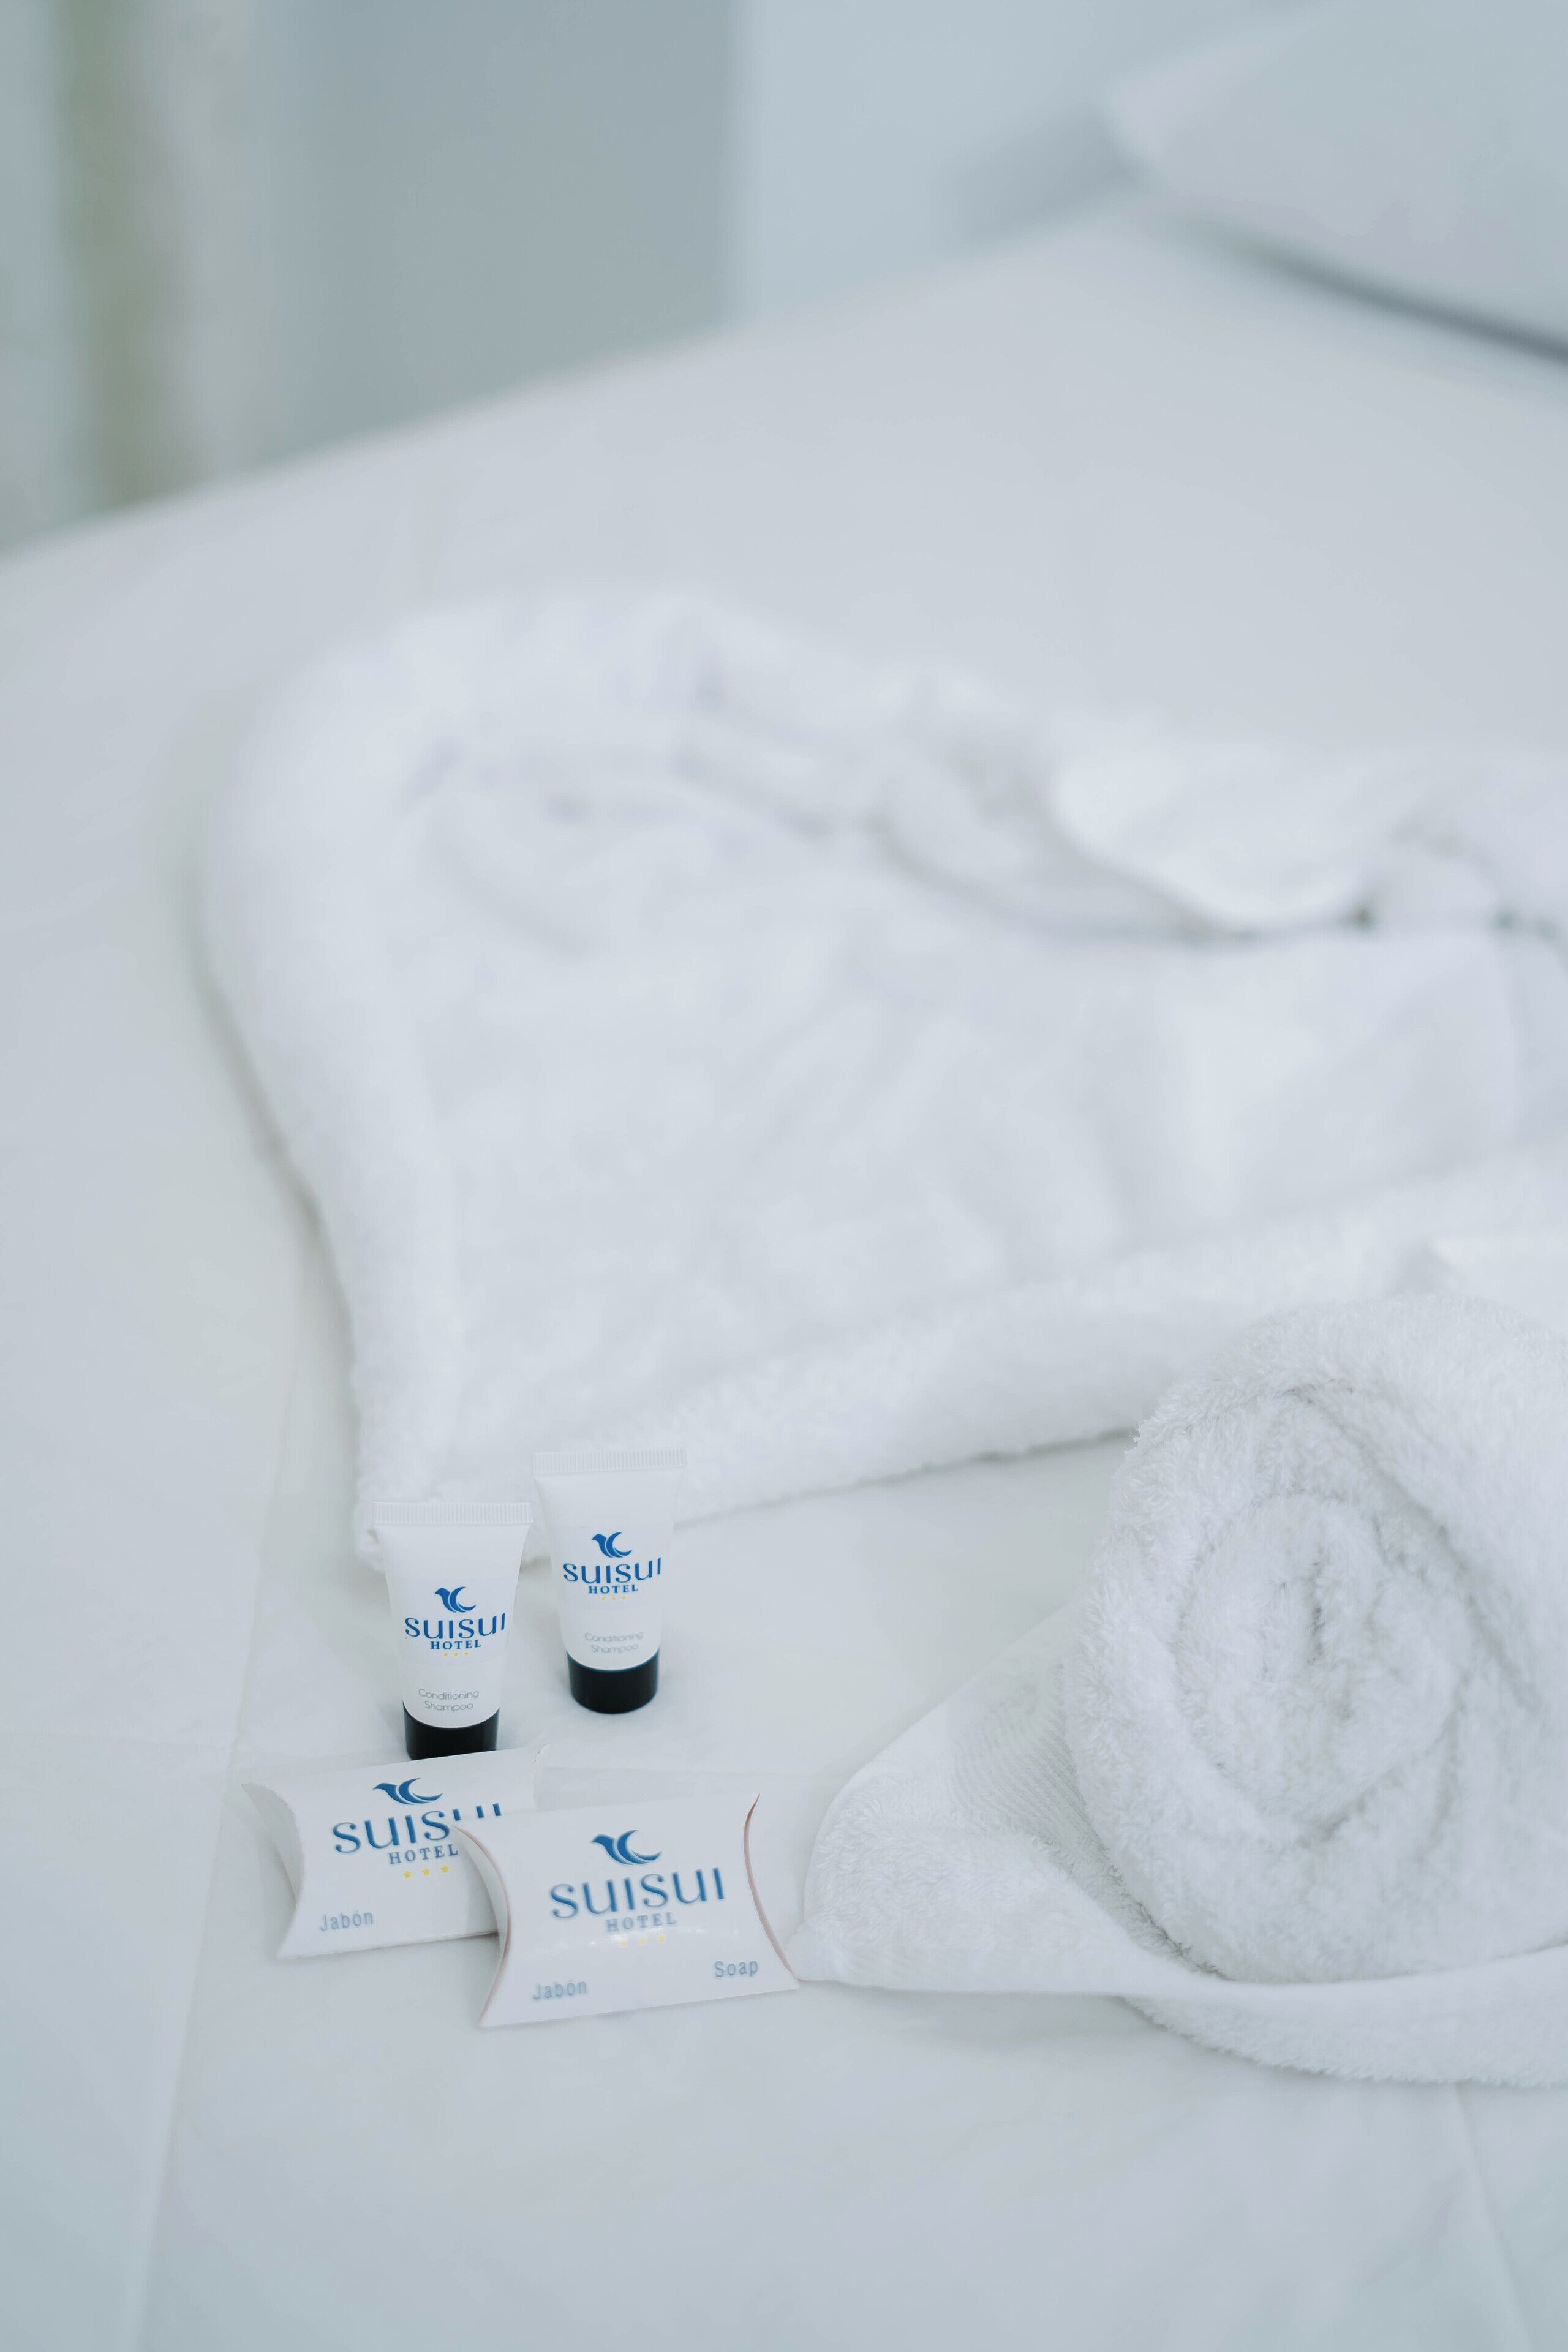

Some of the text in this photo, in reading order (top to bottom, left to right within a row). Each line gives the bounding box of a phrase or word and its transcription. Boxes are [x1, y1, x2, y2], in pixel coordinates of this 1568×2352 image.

[563, 1558, 661, 1583] SUISUI
[589, 1585, 638, 1594] HOTEL
[405, 1613, 505, 1639] SUISUI
[431, 1640, 481, 1649] HOTEL
[586, 1631, 644, 1643] Conditioning
[591, 1643, 639, 1654] Shampoo
[418, 1688, 479, 1700] Conditioning
[424, 1701, 473, 1713] Shampoo
[388, 1844, 458, 1864] HOTEL
[550, 1867, 725, 1918] SUISUI
[320, 1910, 374, 1932] Jabón
[606, 1912, 676, 1932] HOTEL
[533, 1959, 758, 2000] Jabón Soap
